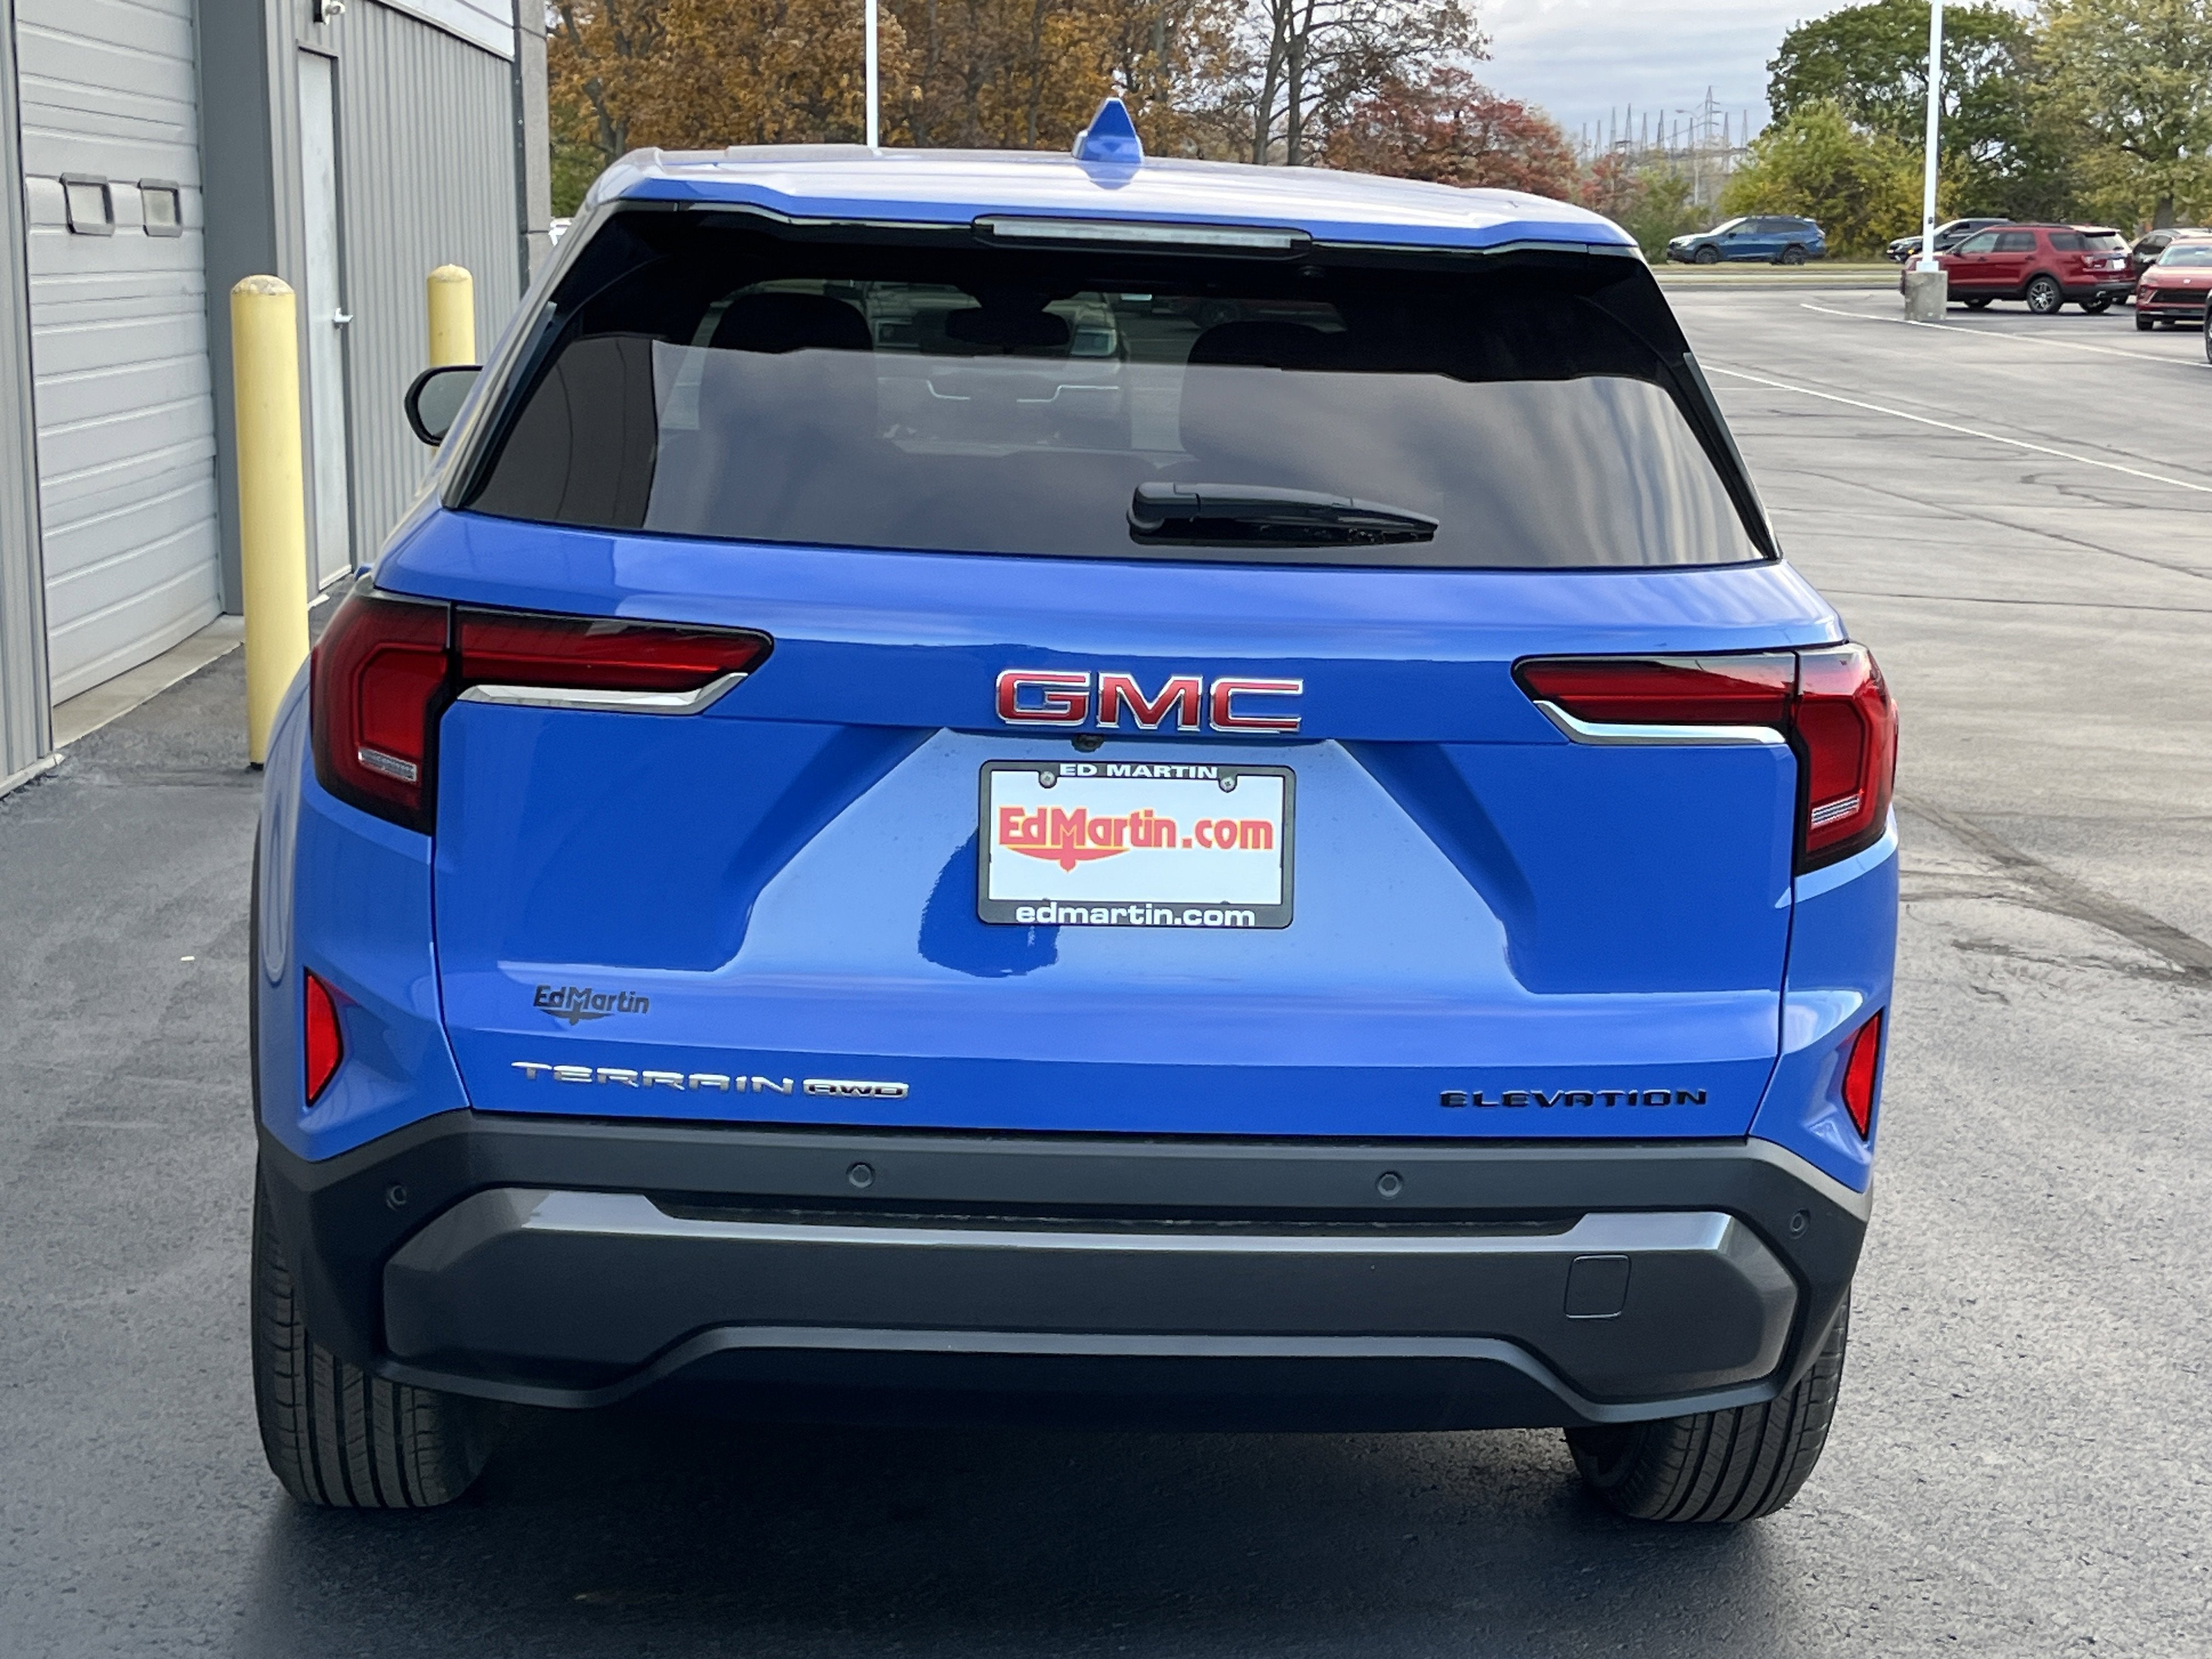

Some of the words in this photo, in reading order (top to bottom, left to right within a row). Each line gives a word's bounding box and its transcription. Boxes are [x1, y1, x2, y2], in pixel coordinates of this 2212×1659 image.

[996, 669, 1303, 732] GMC
[1059, 764, 1097, 777] ED
[1106, 765, 1218, 779] MARTIN
[998, 806, 1273, 850] EdMartin.com
[1015, 901, 1255, 926] edmartin.com
[533, 985, 650, 1015] EdMartin
[511, 1061, 794, 1096] TERRAIN
[804, 1079, 909, 1099] AWD
[1440, 1088, 1707, 1107] ELEVATION
